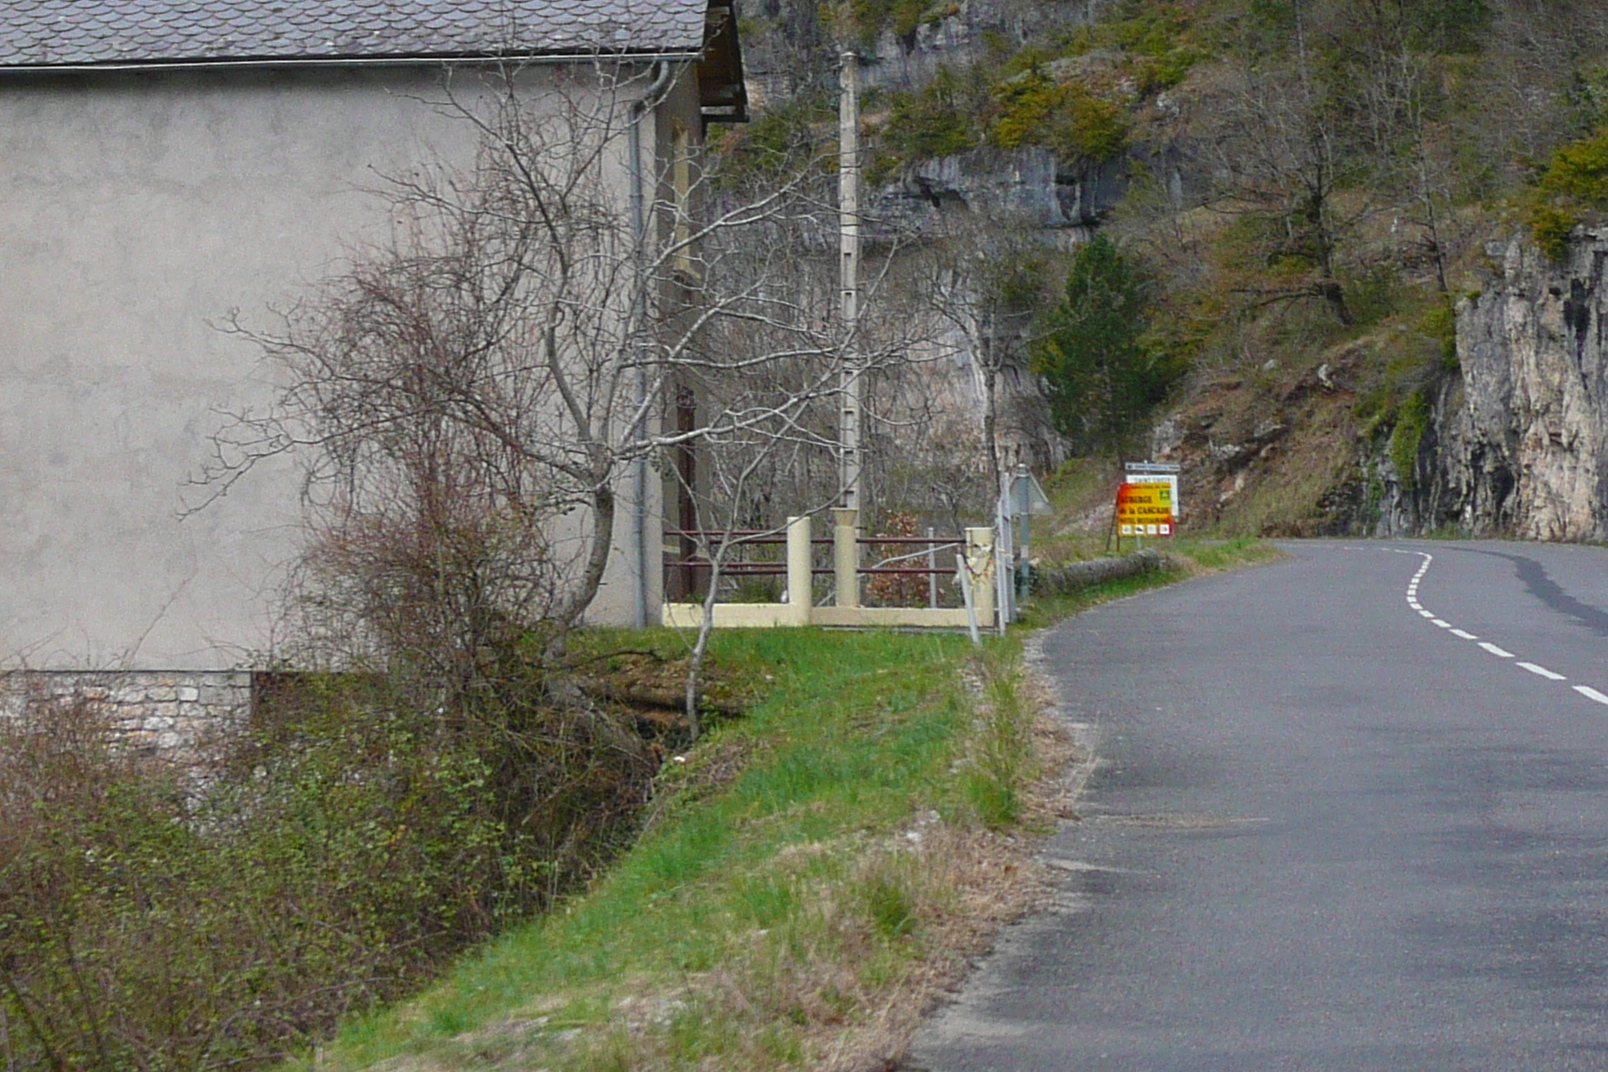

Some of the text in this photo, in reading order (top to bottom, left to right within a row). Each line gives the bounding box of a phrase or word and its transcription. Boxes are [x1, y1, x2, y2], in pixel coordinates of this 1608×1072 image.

[1121, 496, 1152, 504] AUBERGE
[1129, 506, 1135, 514] la
[1137, 506, 1169, 514] CASCADE
